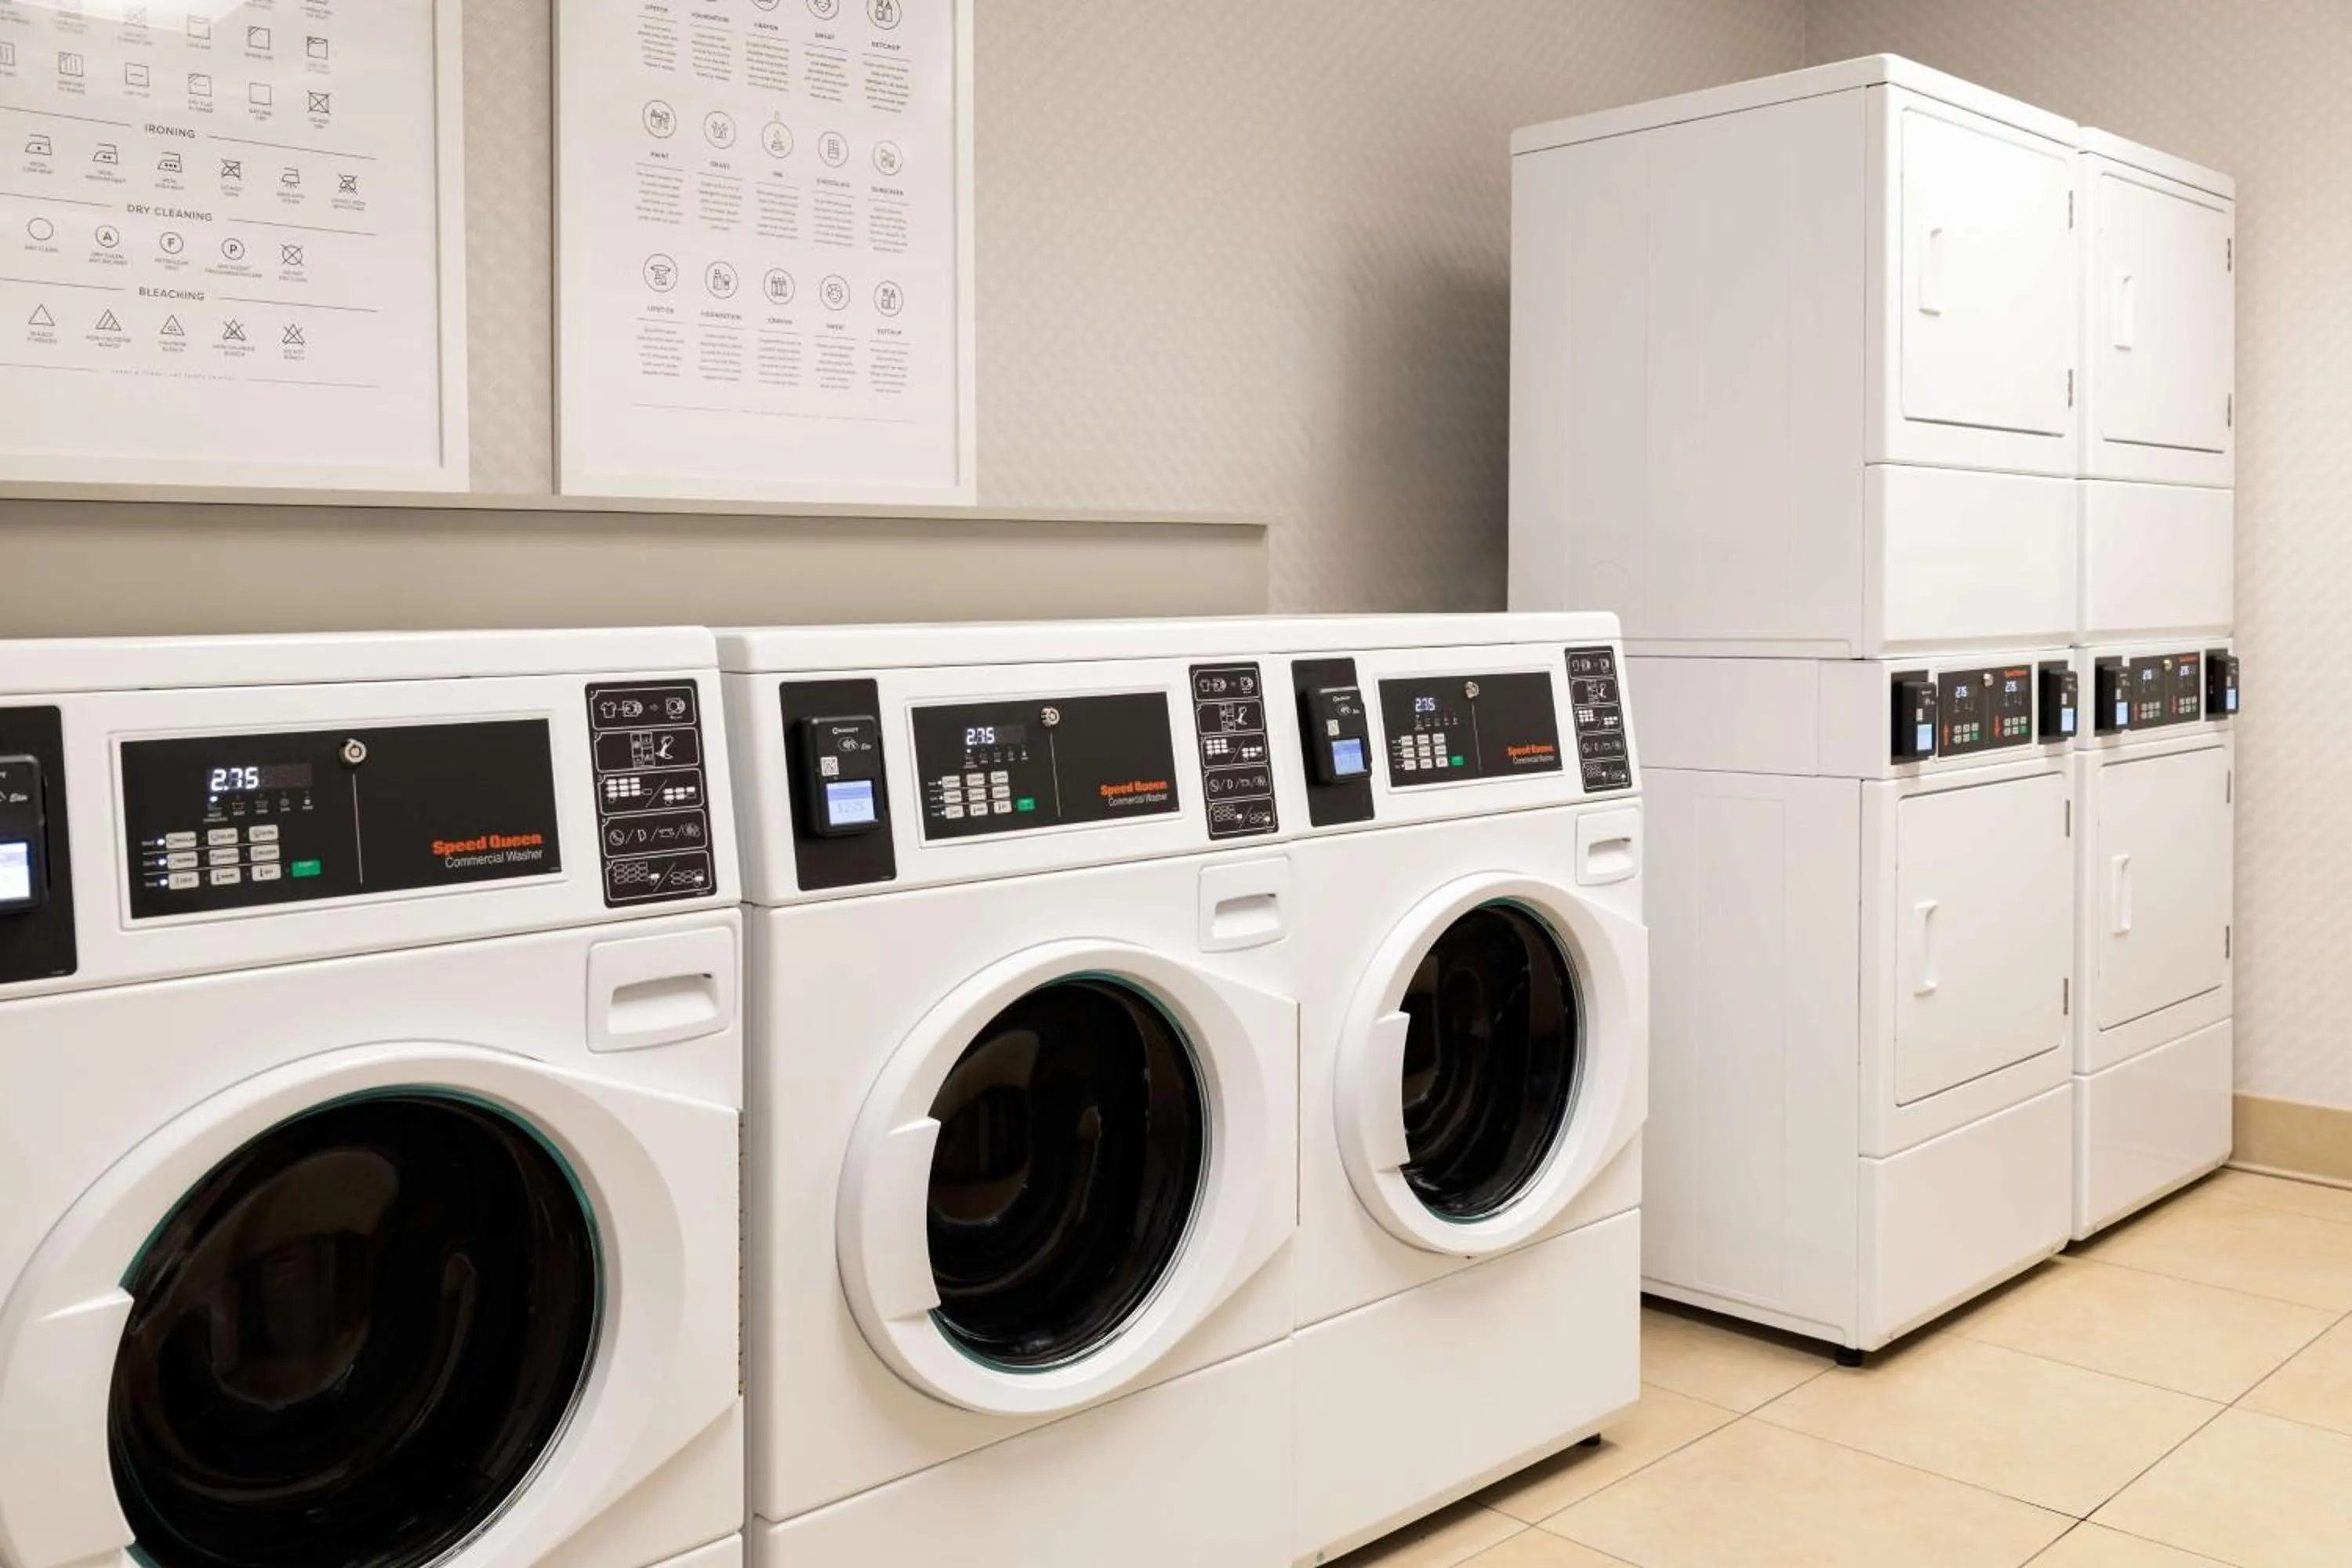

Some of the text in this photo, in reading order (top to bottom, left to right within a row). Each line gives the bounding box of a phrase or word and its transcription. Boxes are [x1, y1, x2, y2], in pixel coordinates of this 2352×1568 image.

[144, 123, 197, 140] IRONING
[126, 203, 214, 222] DRY CLEANING
[103, 231, 112, 241] A
[167, 238, 176, 248] F
[230, 244, 238, 254] P
[139, 286, 205, 302] BLEACHING
[965, 727, 996, 746] 2.75
[209, 766, 260, 792] 2.75
[1100, 780, 1167, 798] Speed Queen
[1107, 793, 1168, 809] Commercial Washer
[432, 833, 543, 857] Speed Queen
[445, 849, 543, 869] Commercial Washer
